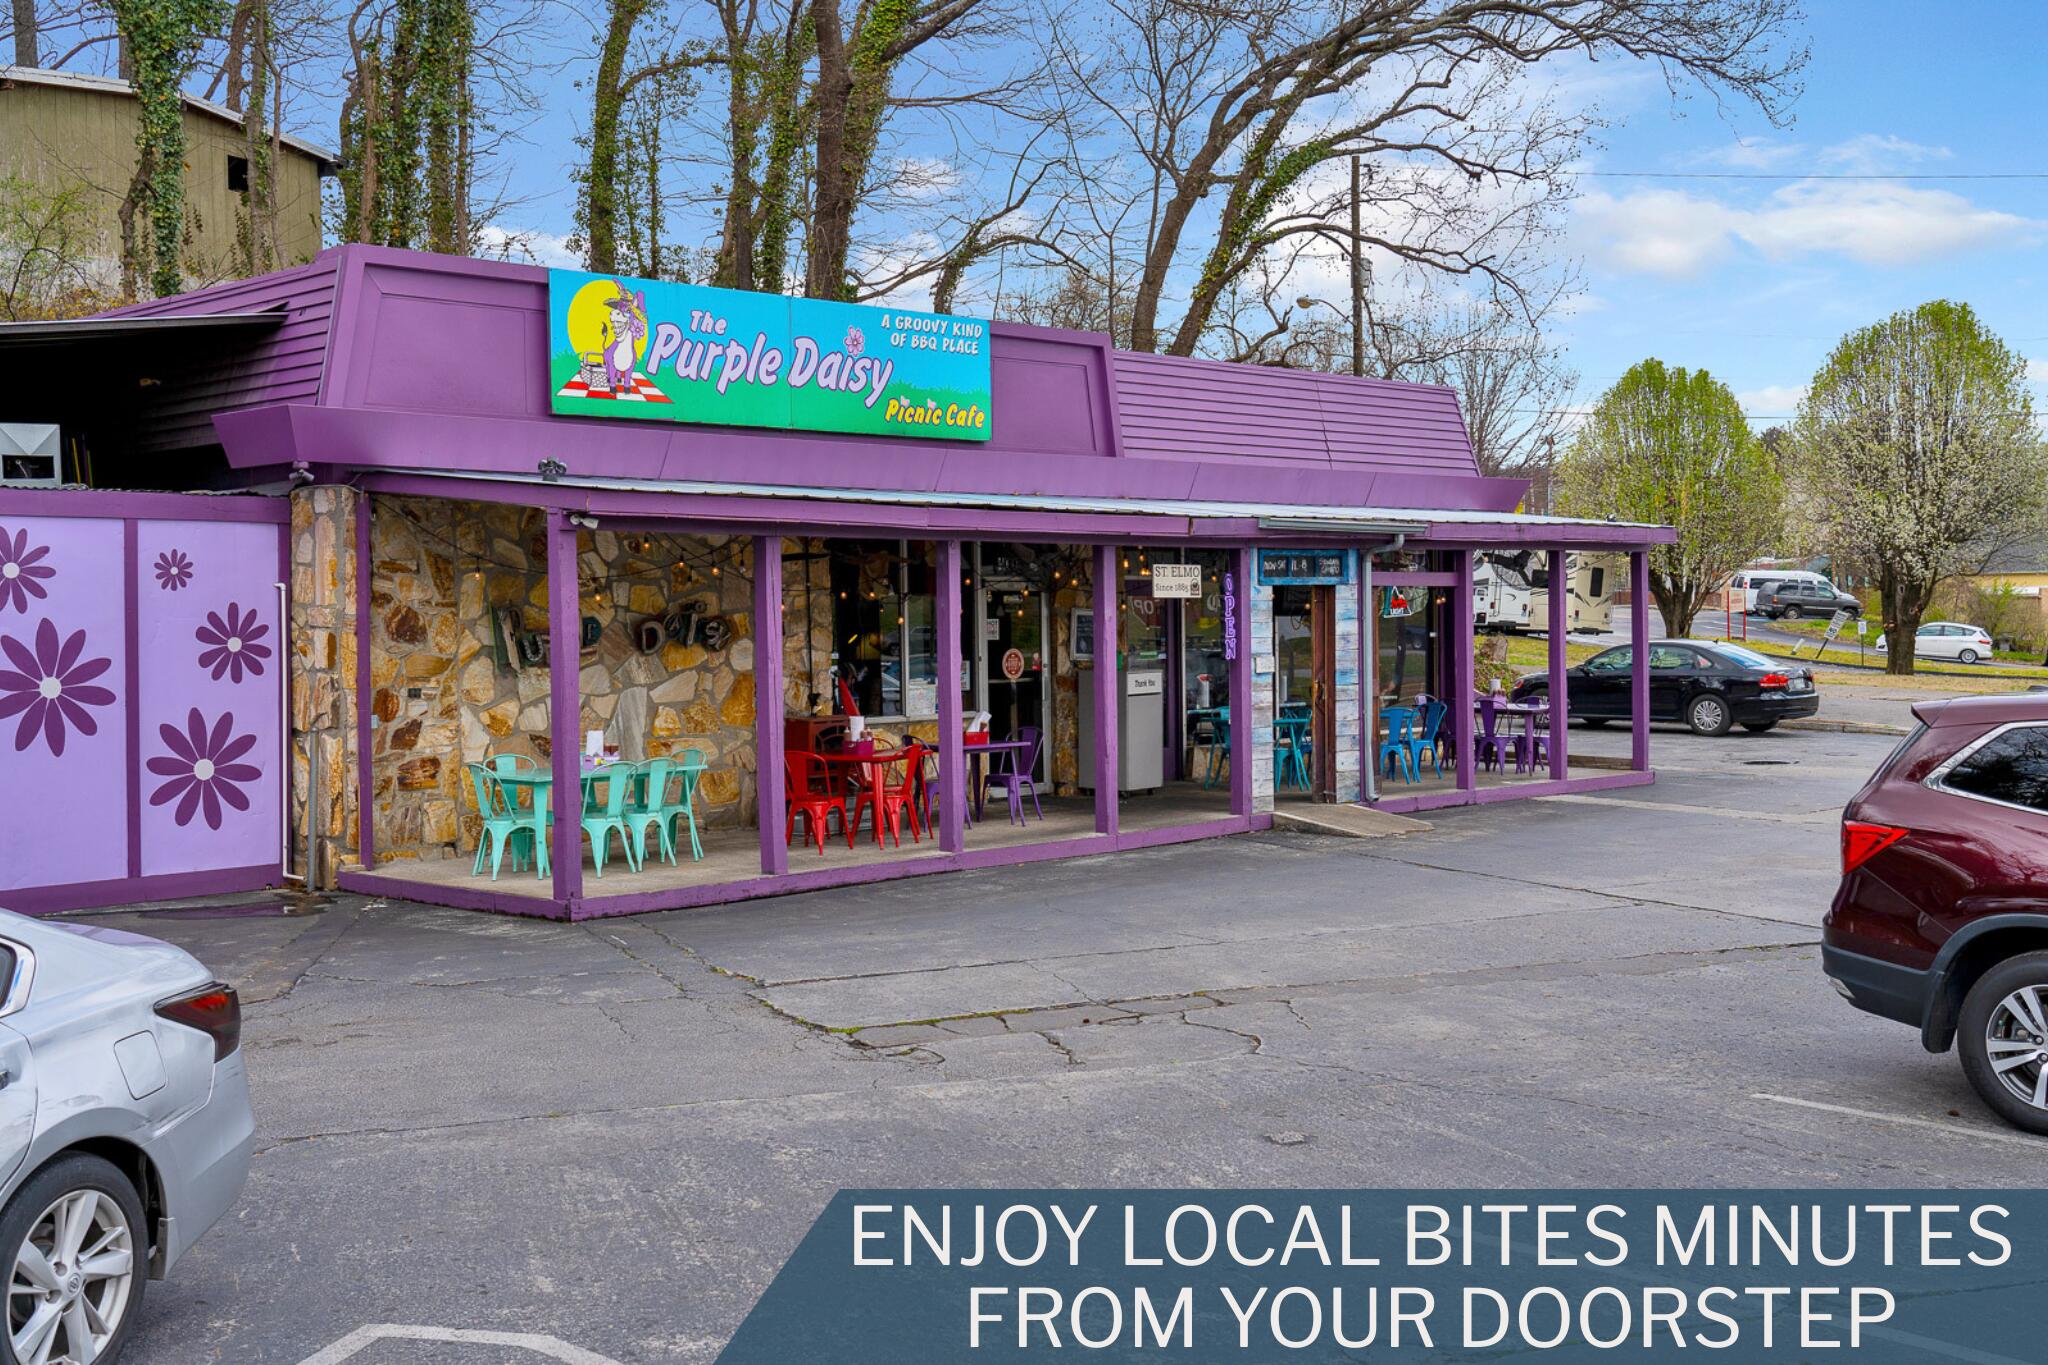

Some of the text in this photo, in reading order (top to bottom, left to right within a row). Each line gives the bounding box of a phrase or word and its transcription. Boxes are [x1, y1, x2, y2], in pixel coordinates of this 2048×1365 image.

[690, 310, 727, 335] The
[881, 314, 983, 338] A GROOVY KIND
[890, 332, 980, 355] OF BBQ PLACE
[646, 322, 895, 409] Purple Daisy
[885, 397, 985, 428] Picnic Cafe
[1171, 566, 1200, 578] ELMO
[1155, 583, 1174, 592] Since
[1224, 572, 1237, 660] OPEN
[1135, 679, 1147, 688] Thank
